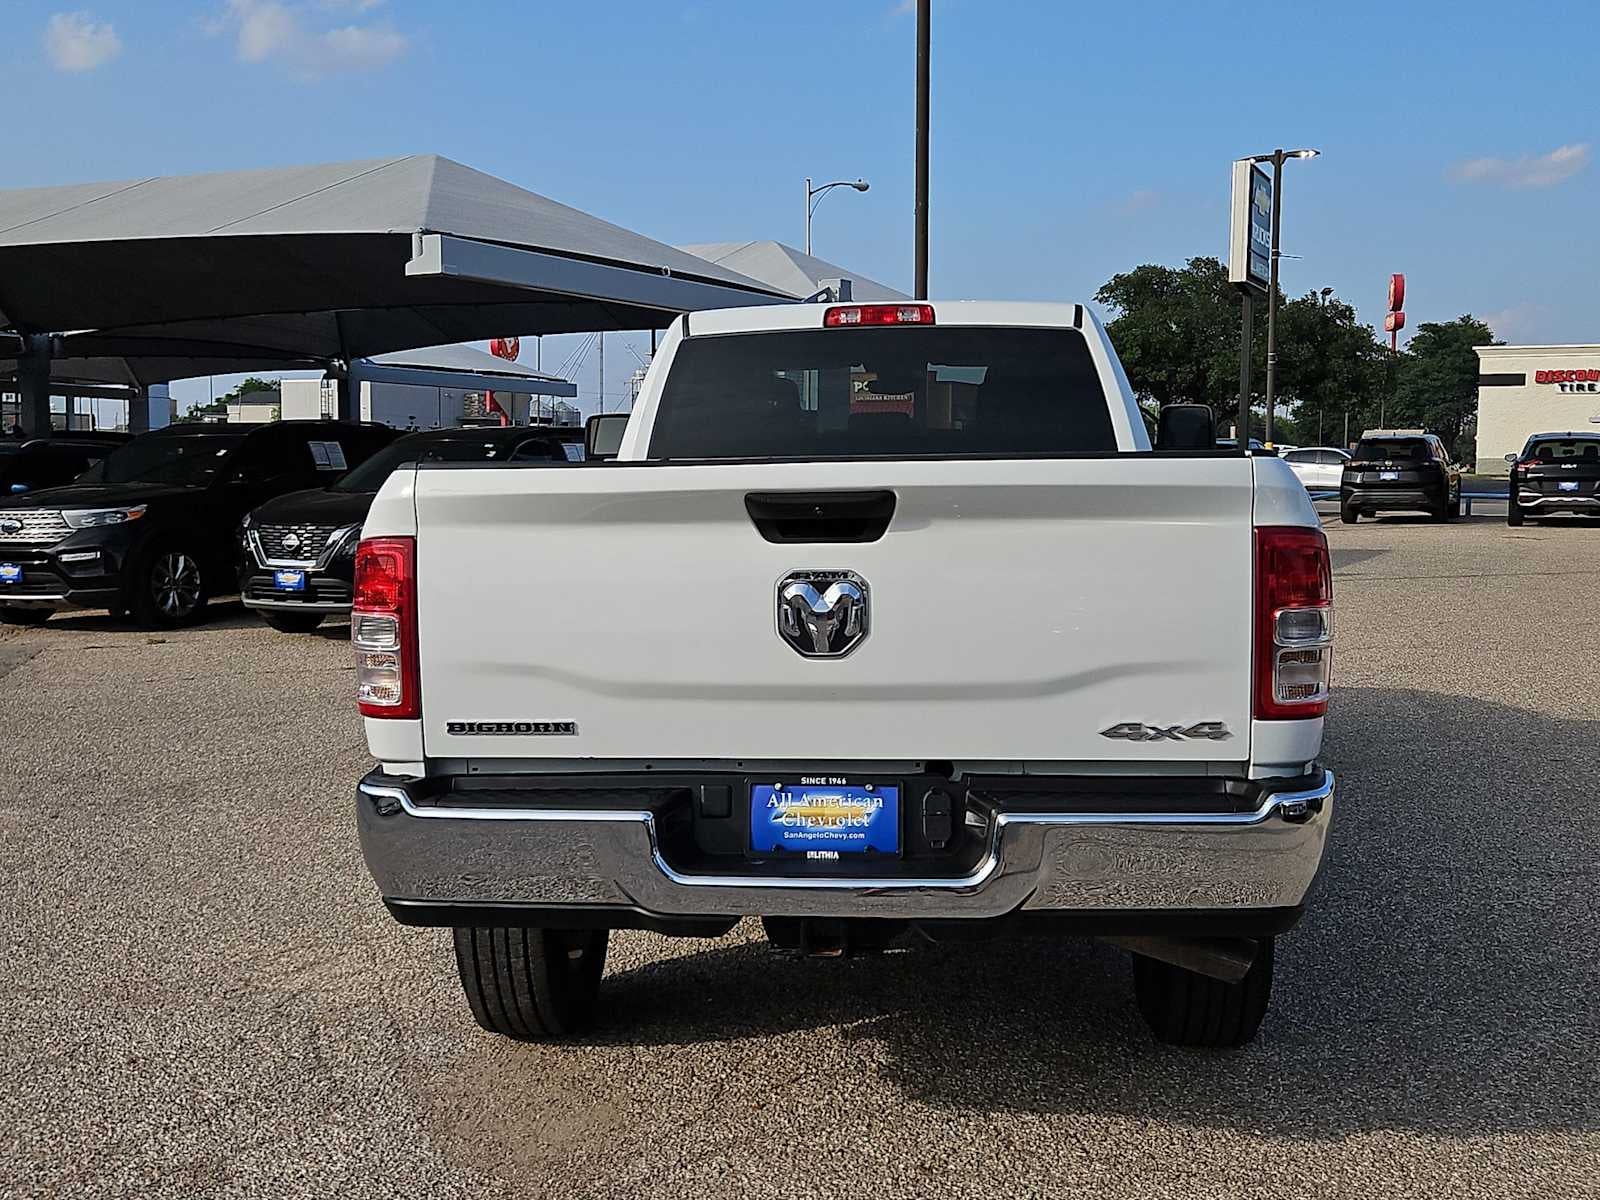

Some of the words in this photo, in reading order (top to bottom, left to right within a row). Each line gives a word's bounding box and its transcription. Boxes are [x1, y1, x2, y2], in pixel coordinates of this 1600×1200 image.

[1535, 369, 1600, 384] DISCOU
[1559, 383, 1598, 392] TIRE
[446, 722, 577, 735] BIGHORN
[800, 776, 827, 785] SINCE
[766, 793, 792, 809] All
[799, 793, 884, 808] American
[782, 811, 870, 828] Chevrolet
[783, 831, 865, 840] SanAngeloChevy.com
